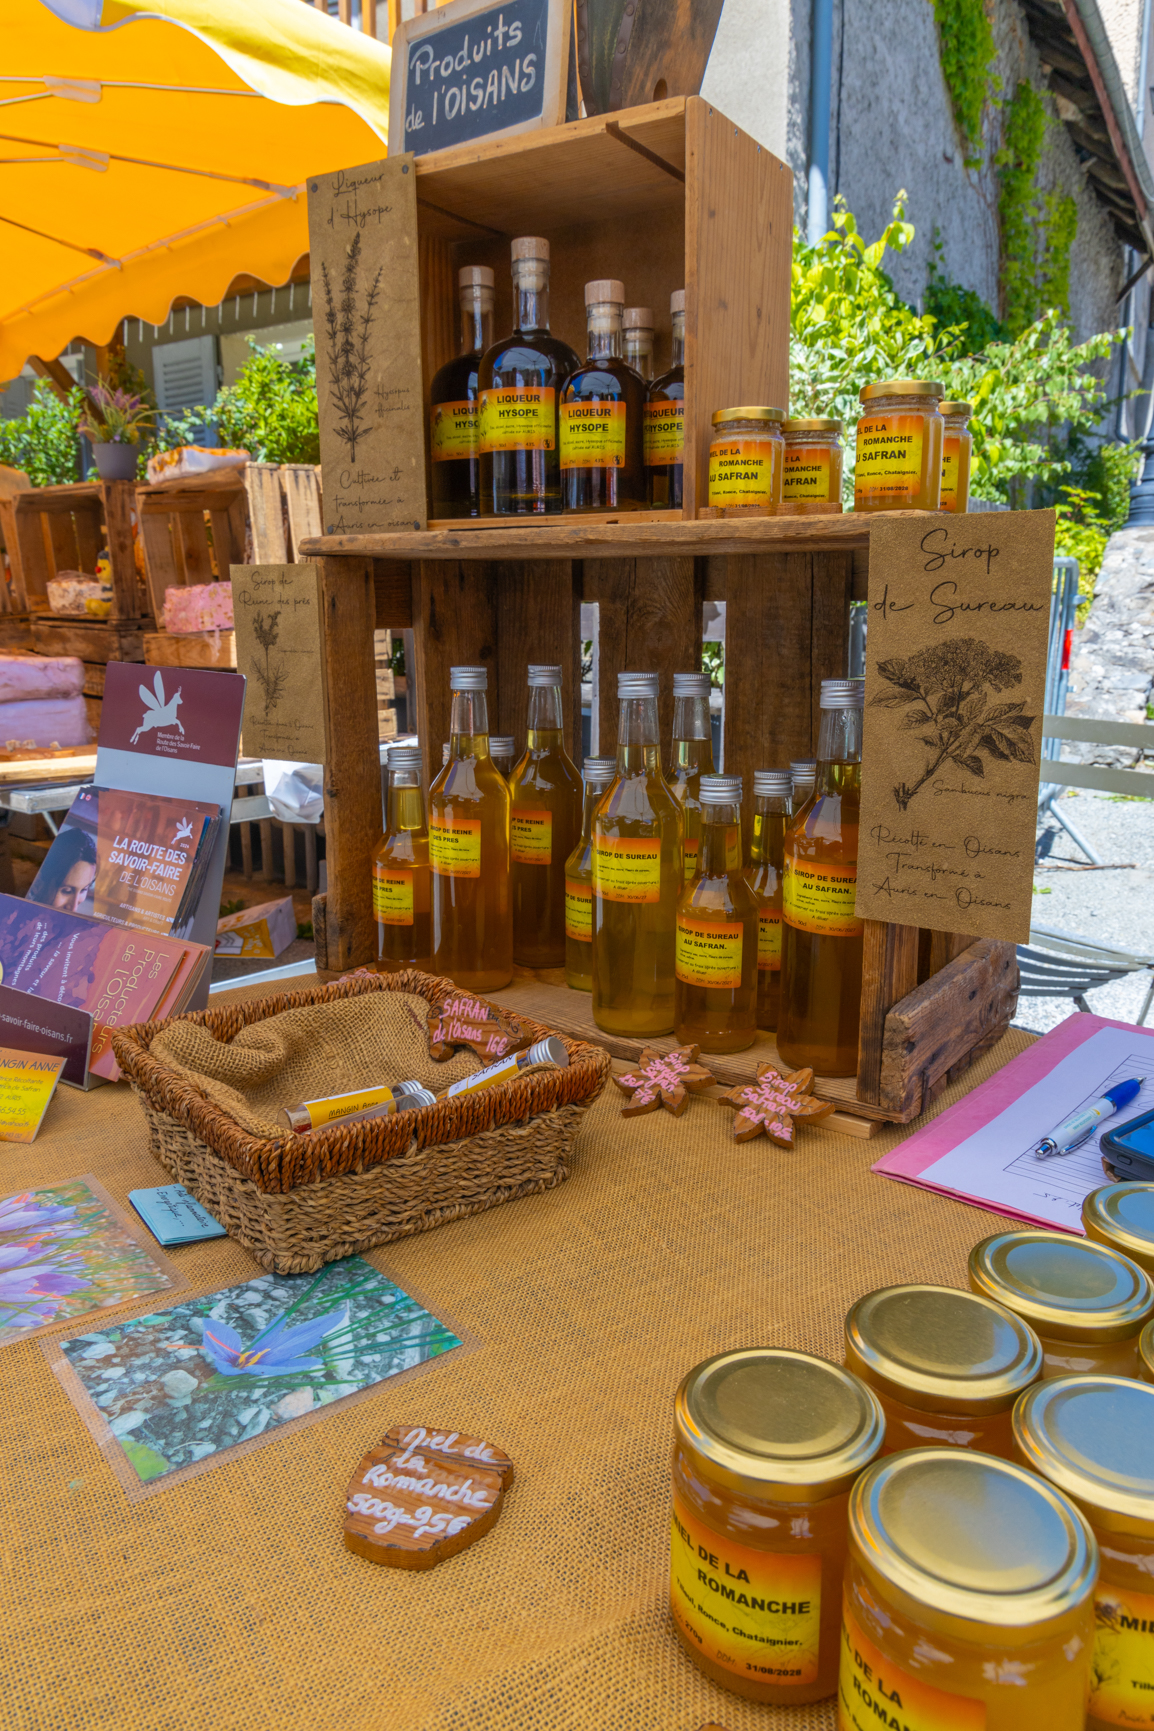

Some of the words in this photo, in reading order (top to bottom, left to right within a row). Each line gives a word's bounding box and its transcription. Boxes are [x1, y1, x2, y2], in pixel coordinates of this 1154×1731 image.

[410, 14, 522, 85] Produits
[406, 104, 424, 132] de
[433, 53, 537, 124] l'OISANS
[332, 170, 385, 197] Liqueur
[327, 199, 392, 229] d'Hysope
[568, 409, 611, 418] LIQUEUR
[864, 436, 913, 445] ROMANCHE
[862, 450, 906, 461] SAFRAN
[718, 472, 758, 481] SAFRAN
[921, 528, 999, 574] Sirop
[251, 571, 276, 592] Sirop
[279, 571, 293, 585] de
[874, 584, 914, 620] de
[930, 581, 1043, 624] Sureau
[932, 780, 990, 796] Sambucus
[997, 792, 1029, 803] nigra
[113, 836, 127, 850] LA
[129, 842, 165, 859] ROUTE
[165, 849, 187, 865] DES
[871, 825, 929, 851] Récolté
[964, 836, 1020, 858] Oisans
[109, 851, 182, 881] SAVOIR-FAIRE
[794, 870, 815, 879] SIROP
[886, 853, 969, 880] Transformé
[119, 871, 134, 885] DE
[133, 874, 176, 896] L'OISANS
[815, 885, 852, 894] SAFRAN.
[872, 877, 917, 897] Auris
[956, 887, 1011, 909] Oisans
[119, 903, 140, 913] ARTISANS
[145, 911, 165, 920] ARTISTES
[68, 933, 80, 950] Vous
[678, 926, 693, 935] SIROP
[25, 944, 42, 971] produits
[122, 944, 136, 963] de
[694, 941, 727, 950] SAFRAN.
[12, 950, 31, 985] montagnes
[39, 958, 55, 978] saveur
[62, 951, 73, 978] invitent
[149, 953, 169, 979] Les
[92, 948, 154, 1054] Producteurs
[439, 998, 489, 1021] SAFRAN
[433, 1023, 446, 1042] de
[486, 1033, 507, 1056] 16€
[29, 1061, 60, 1072] ANNE
[665, 1053, 690, 1073] Sirop
[759, 1072, 797, 1096] Sirop
[329, 1105, 359, 1117] MANGIN
[464, 1441, 498, 1463] de
[362, 1464, 493, 1507] Romanche
[699, 1545, 719, 1569] DE
[725, 1563, 750, 1584] LA
[698, 1568, 810, 1614] ROMANCHE
[698, 1605, 730, 1632] Ronce,
[733, 1627, 802, 1646] Chataignier.
[746, 1663, 801, 1676] 31/08/2028
[855, 1649, 873, 1682] DE
[878, 1678, 903, 1709] LA
